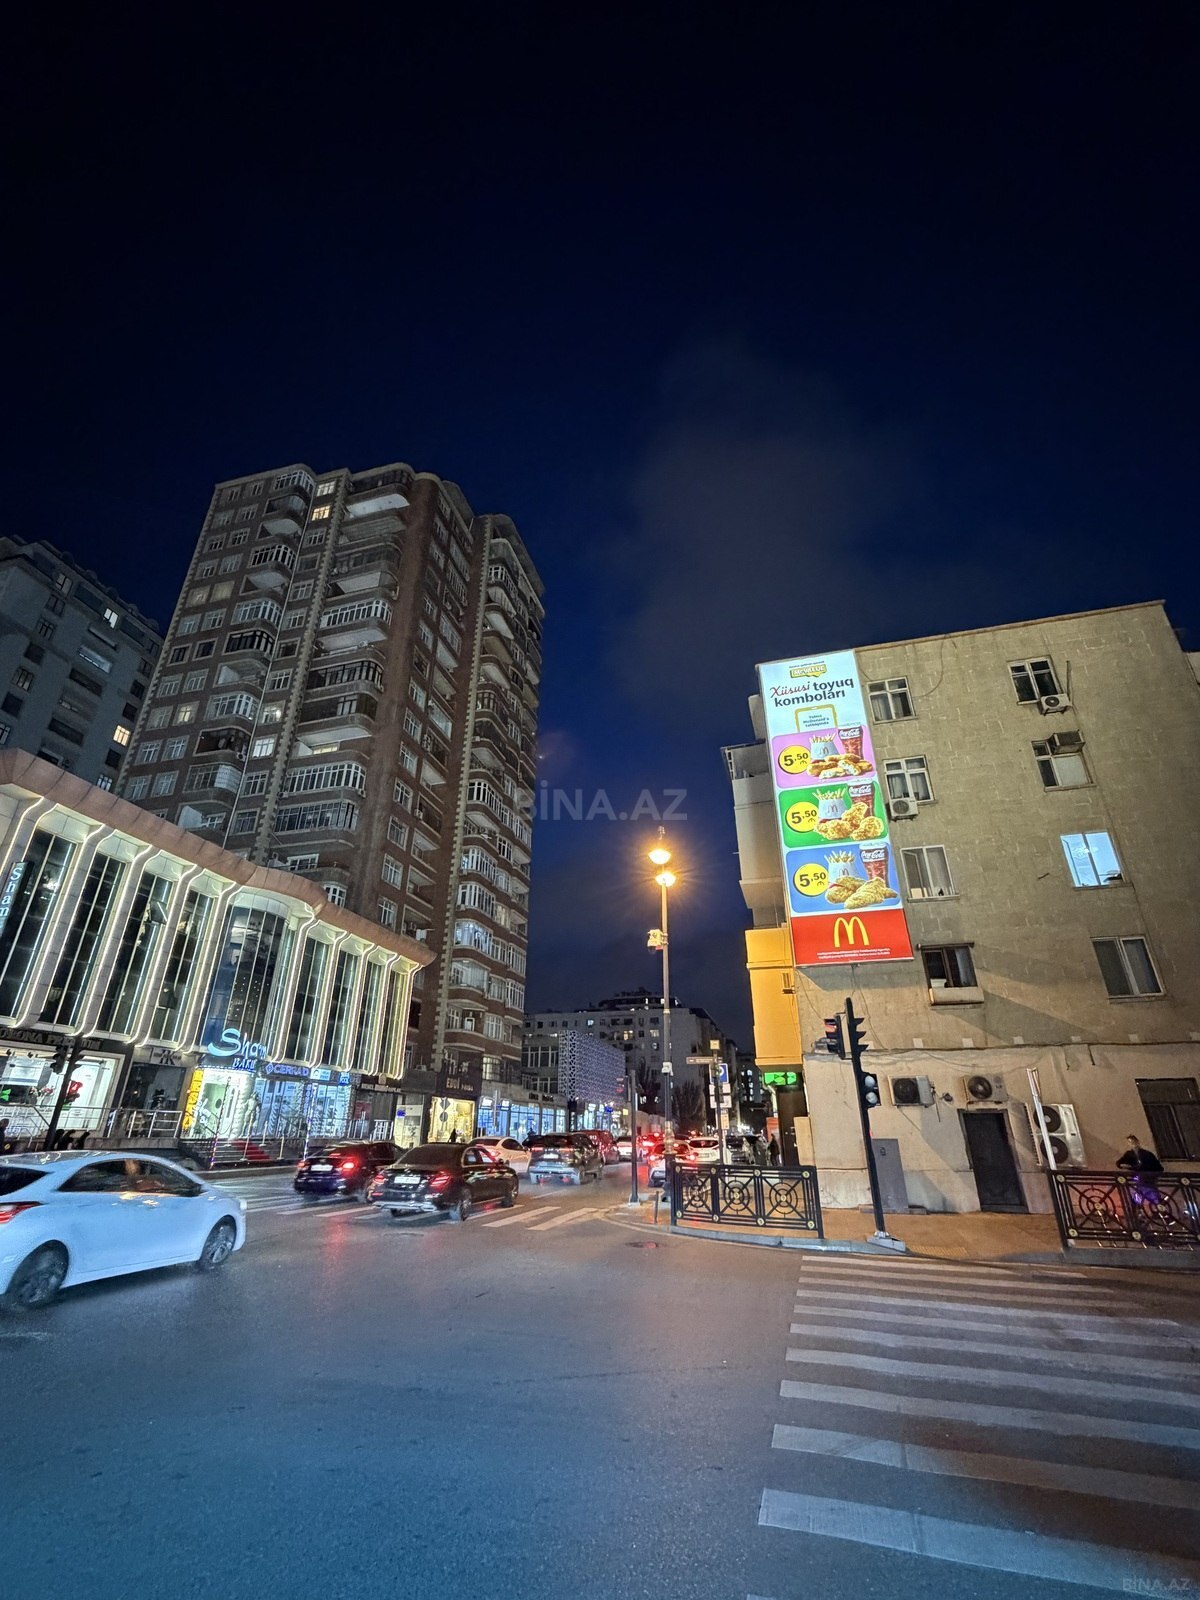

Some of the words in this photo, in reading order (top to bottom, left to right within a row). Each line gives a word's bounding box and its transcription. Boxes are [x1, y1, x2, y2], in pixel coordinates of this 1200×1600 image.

[769, 681, 810, 698] Xüsusi
[813, 678, 854, 692] toyuq
[774, 690, 846, 707] komboları
[791, 809, 817, 824] 5,50
[799, 872, 826, 887] 5,50
